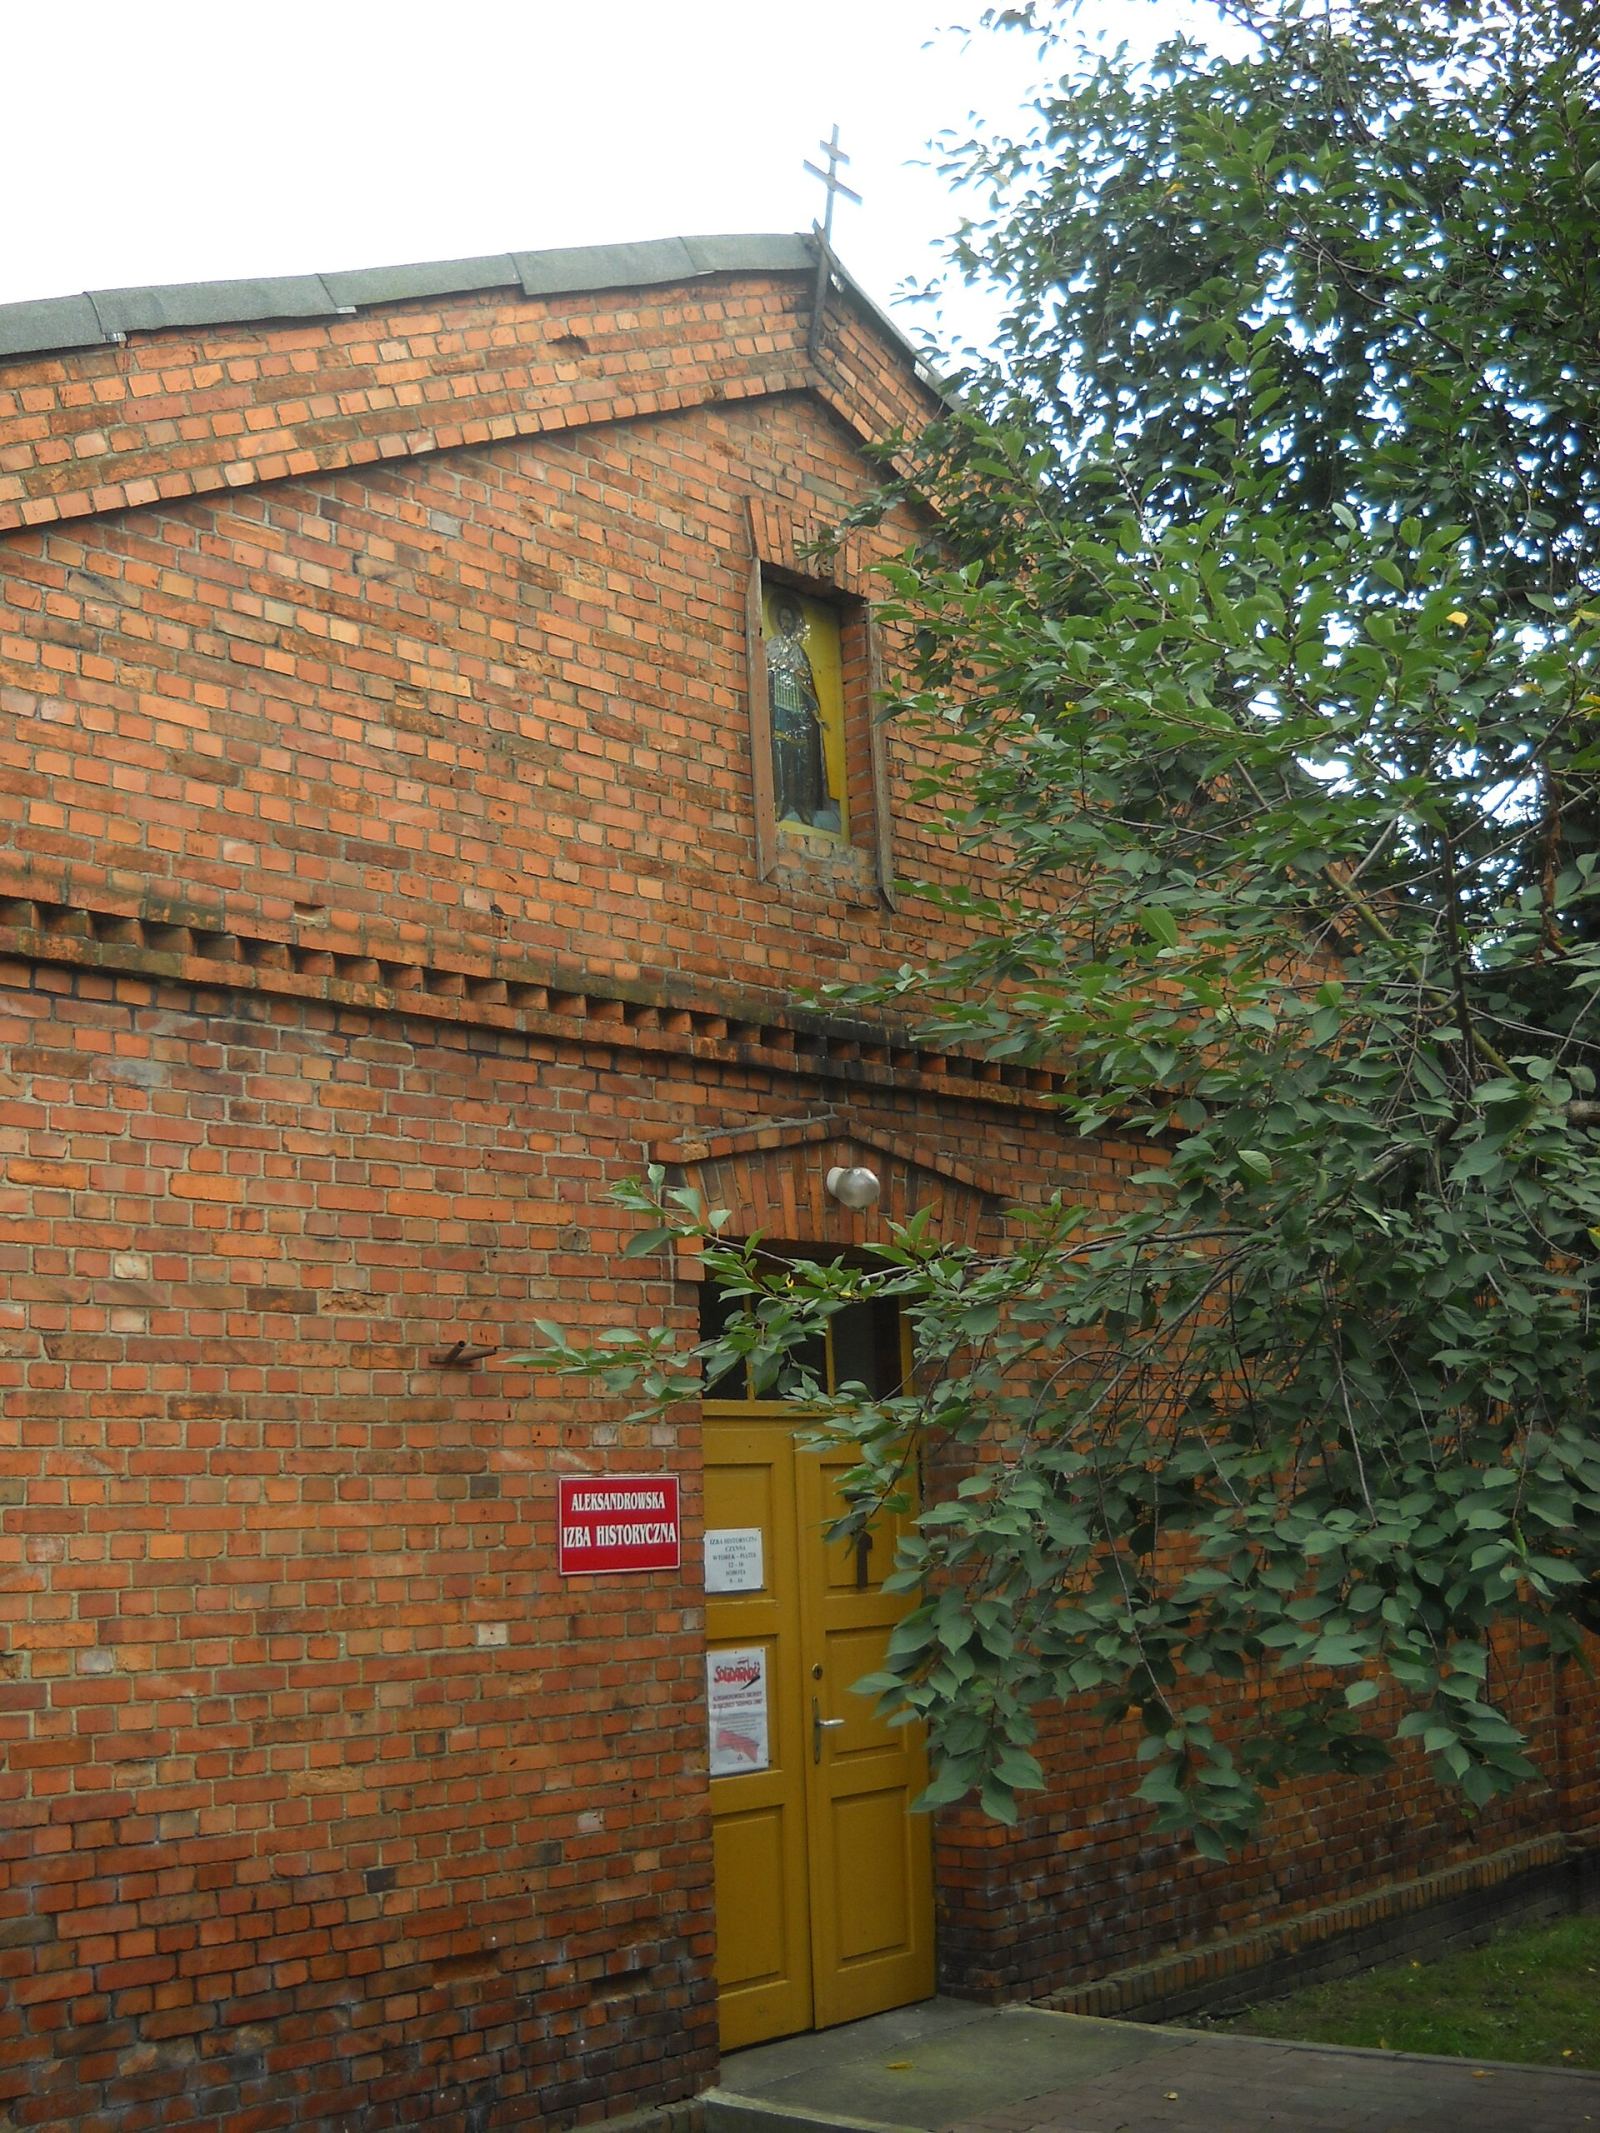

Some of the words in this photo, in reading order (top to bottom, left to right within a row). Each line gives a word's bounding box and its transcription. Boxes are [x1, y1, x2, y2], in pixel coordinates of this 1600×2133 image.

[571, 1491, 666, 1511] ALEKSANDROWSKA
[563, 1526, 592, 1548] IZBA
[596, 1522, 676, 1546] HISTORYCZNA
